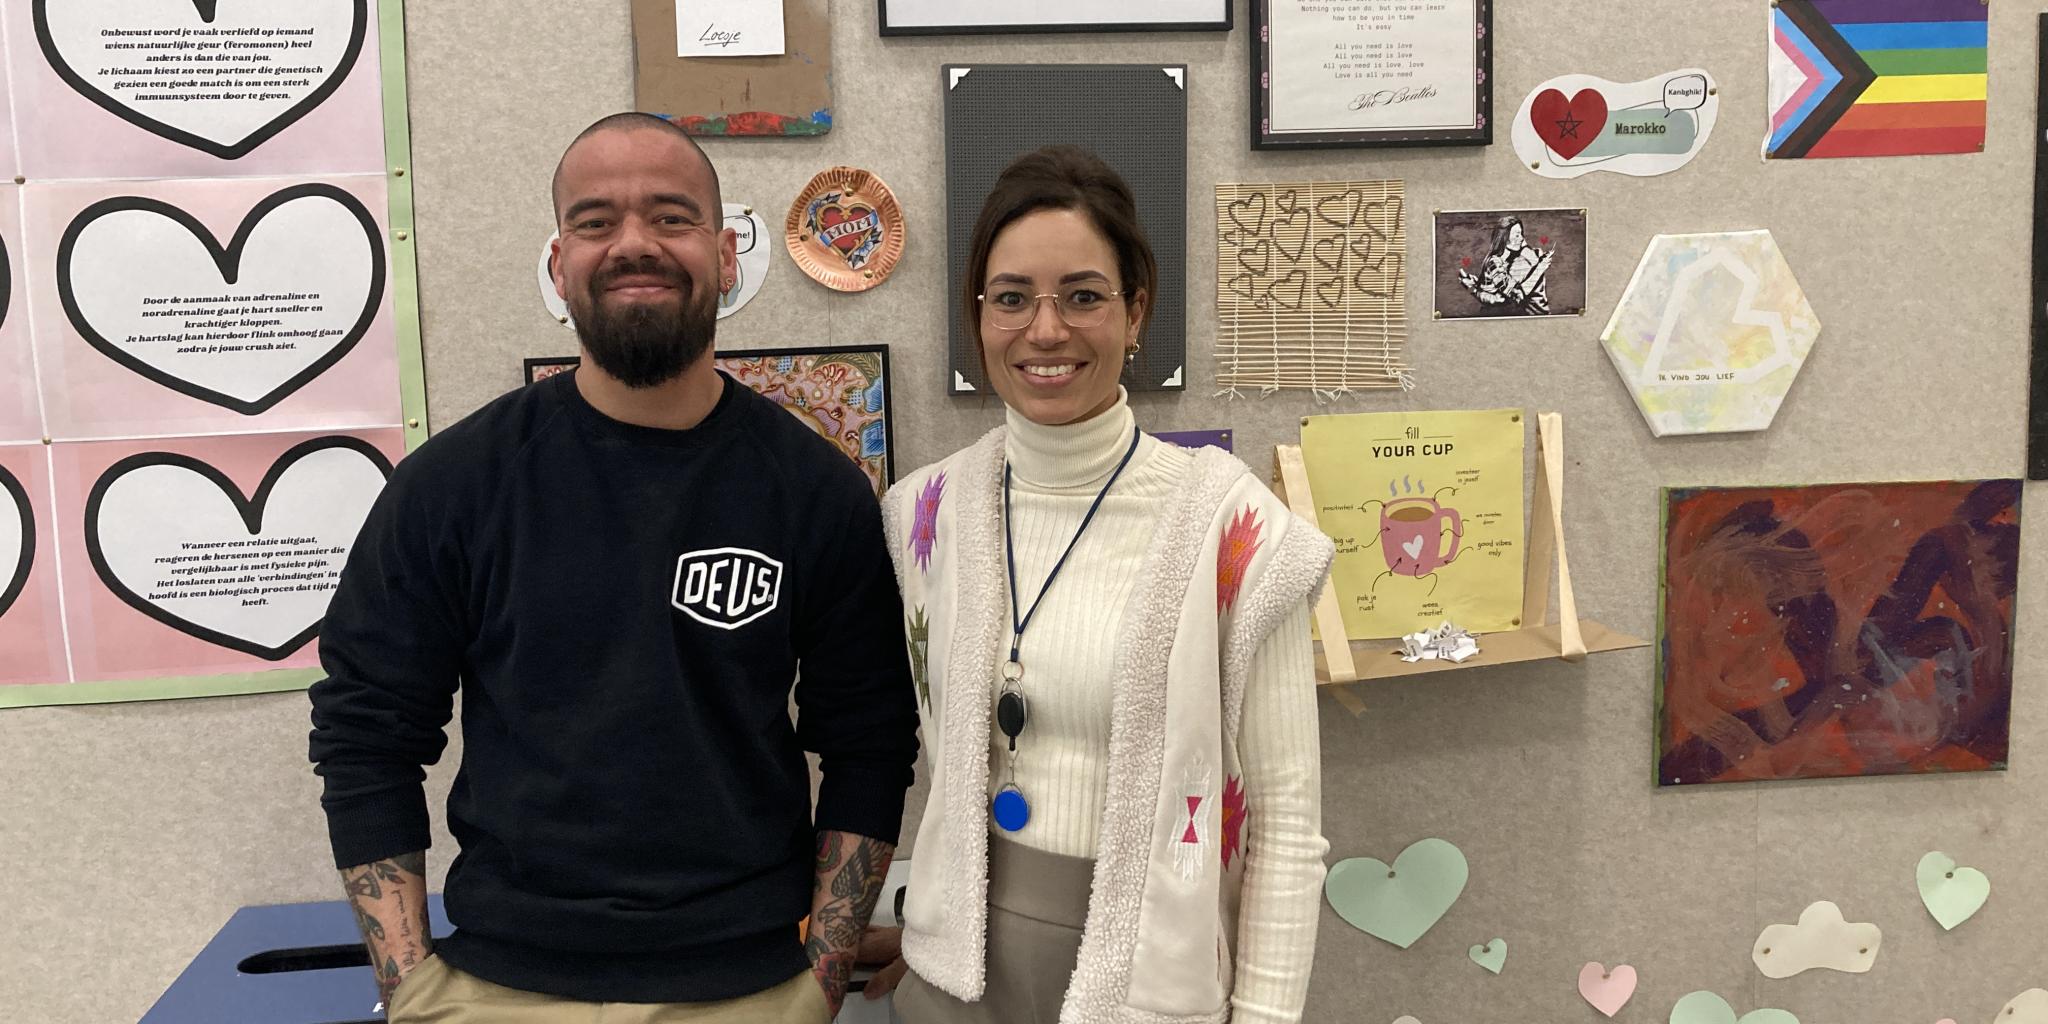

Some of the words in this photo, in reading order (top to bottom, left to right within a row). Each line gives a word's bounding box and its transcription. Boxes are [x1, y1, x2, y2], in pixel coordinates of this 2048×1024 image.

[100, 28, 152, 37] Onbewust
[153, 28, 181, 36] word
[181, 28, 191, 38] je
[193, 28, 218, 36] vaak
[220, 27, 260, 36] verliefd
[261, 29, 274, 38] op
[275, 27, 314, 36] iemand
[104, 41, 135, 50] wiens
[136, 40, 195, 51] natuurlijke
[196, 41, 221, 51] geur
[223, 40, 289, 51] (feromonen)
[290, 40, 312, 49] heel
[146, 54, 181, 62] anders
[183, 53, 192, 62] is
[194, 53, 213, 62] dan
[215, 53, 230, 62] die
[252, 53, 271, 64] jou.
[97, 68, 109, 76] Je
[110, 67, 152, 76] lichaam
[154, 67, 180, 75] kiest
[215, 67, 256, 77] partner
[257, 66, 273, 75] die
[274, 65, 323, 76] genetisch
[113, 80, 147, 91] gezien
[168, 79, 198, 90] goede
[199, 79, 232, 88] match
[234, 79, 243, 88] is
[282, 78, 309, 87] sterk
[134, 93, 221, 102] immuunsysteem
[222, 91, 246, 100] door
[258, 92, 290, 102] geven.
[1348, 93, 1377, 111] The
[1373, 84, 1437, 106] Beatles
[1615, 122, 1666, 135] Marokko
[826, 216, 871, 239] MOM
[143, 297, 169, 305] Door
[170, 296, 181, 304] de
[182, 294, 231, 304] aanmaak
[252, 292, 306, 302] adrenaline
[142, 308, 215, 318] noradrenaline
[216, 307, 239, 317] gaat
[240, 306, 250, 316] je
[251, 306, 273, 314] hart
[274, 304, 309, 313] sneller
[184, 319, 238, 329] krachtiger
[239, 318, 282, 328] kloppen.
[125, 335, 137, 343] Je
[138, 333, 183, 343] hartslag
[184, 333, 204, 341] kan
[205, 331, 250, 341] hierdoor
[250, 330, 276, 339] flink
[276, 329, 317, 339] omhoog
[318, 328, 344, 338] gaan
[176, 345, 207, 354] zodra
[208, 344, 217, 355] je
[218, 344, 243, 354] jouw
[244, 342, 274, 352] crush
[275, 342, 296, 350] ziet.
[1405, 426, 1419, 439] fill
[1372, 445, 1415, 458] YOUR
[1422, 443, 1454, 456] CUP
[181, 542, 227, 550] Wanneer
[246, 537, 279, 547] relatie
[280, 536, 317, 546] uitgaat,
[154, 555, 199, 565] reageren
[201, 553, 212, 562] de
[213, 552, 259, 561] hersenen
[261, 551, 273, 560] op
[293, 547, 329, 557] manier
[330, 546, 345, 554] die
[171, 565, 238, 576] vergelijkbaar
[240, 563, 249, 572] is
[250, 563, 269, 571] met
[270, 560, 306, 571] fysieke
[307, 559, 328, 569] pijn.
[156, 580, 174, 588] Het
[175, 578, 215, 587] loslaten
[217, 577, 235, 585] van
[237, 575, 255, 584] alle
[257, 570, 327, 582] 'verbindingen'
[327, 570, 337, 578] in
[148, 591, 177, 600] hoofd
[179, 591, 188, 599] is
[208, 586, 259, 597] biologisch
[260, 586, 294, 596] proces
[295, 583, 311, 592] dat
[312, 582, 329, 592] tijd
[684, 557, 772, 617] DEUS
[241, 598, 268, 607] heeft.
